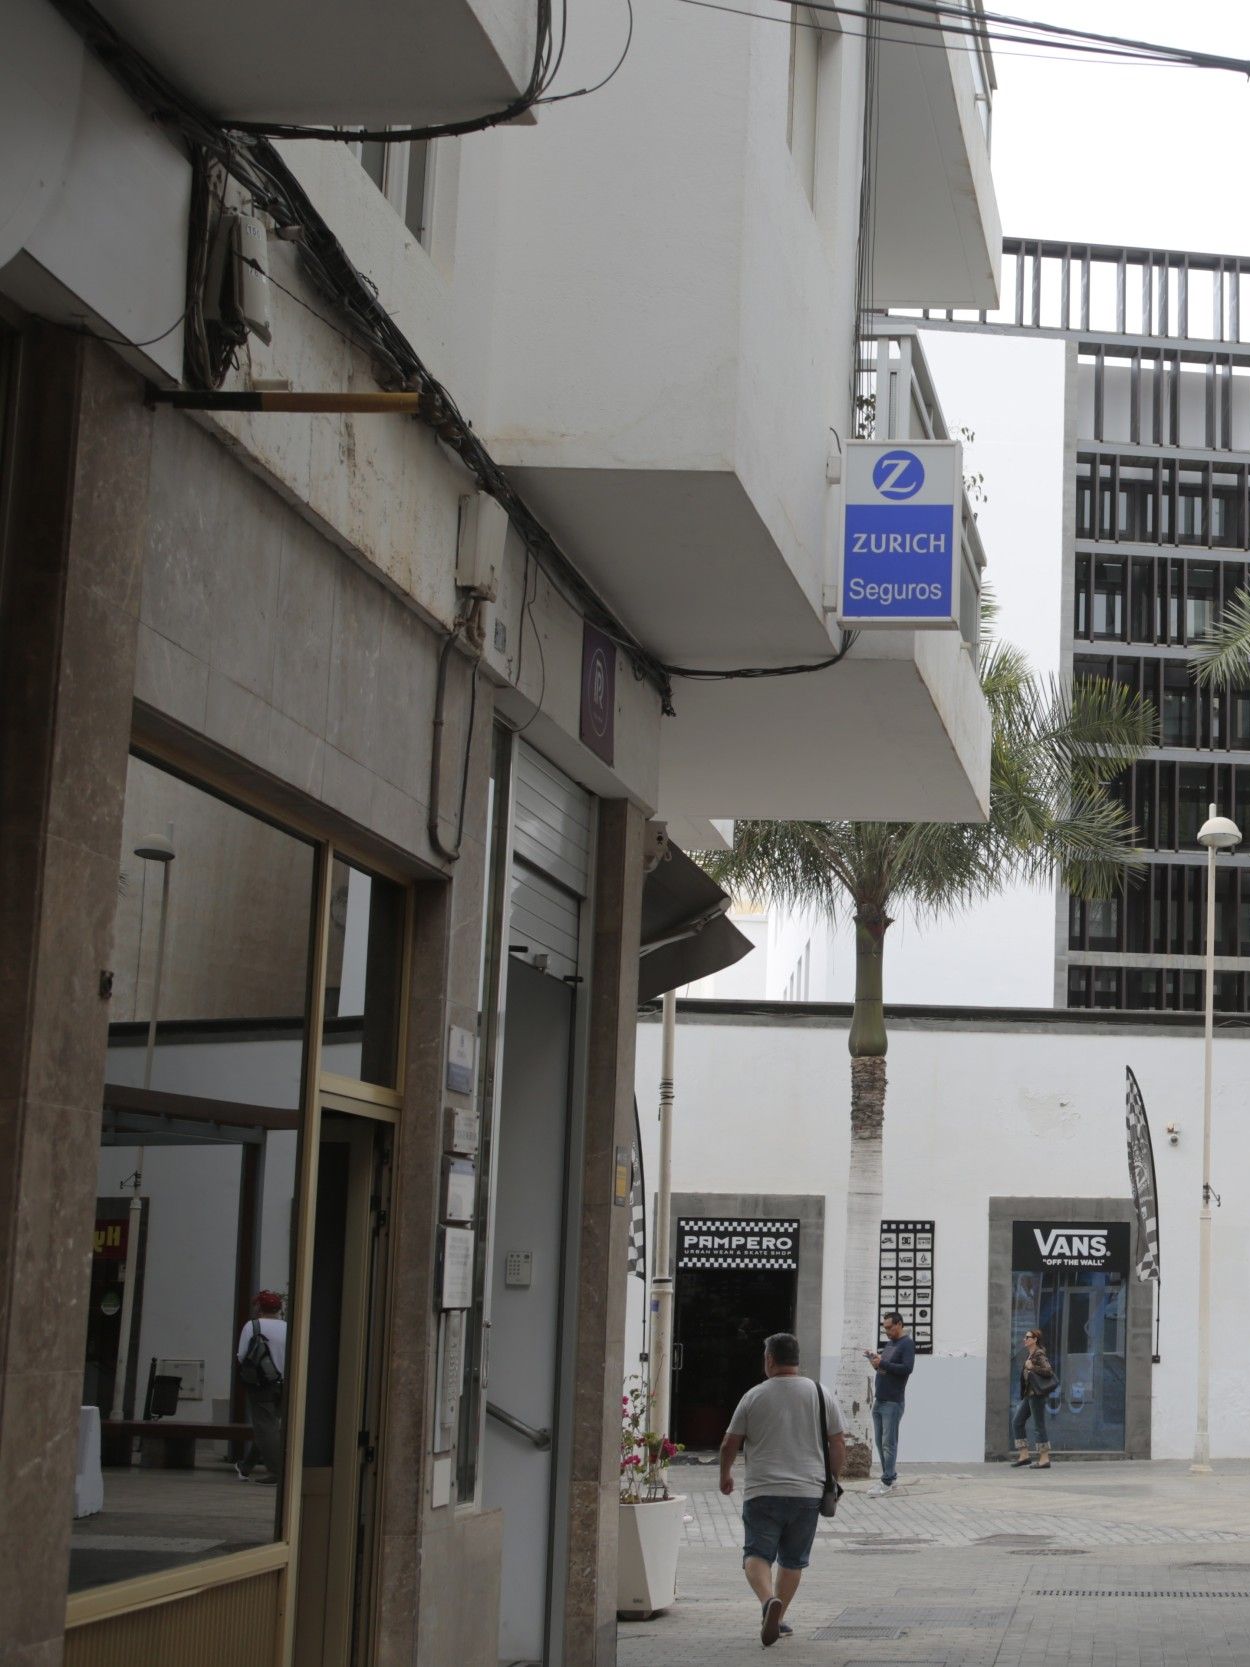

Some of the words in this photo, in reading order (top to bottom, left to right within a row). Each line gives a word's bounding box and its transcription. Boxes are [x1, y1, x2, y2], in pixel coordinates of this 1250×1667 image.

[879, 460, 917, 493] Z
[852, 533, 946, 553] ZURICH
[849, 577, 942, 605] Seguros
[684, 1235, 793, 1250] PAMPERO
[1033, 1228, 1108, 1257] VANS
